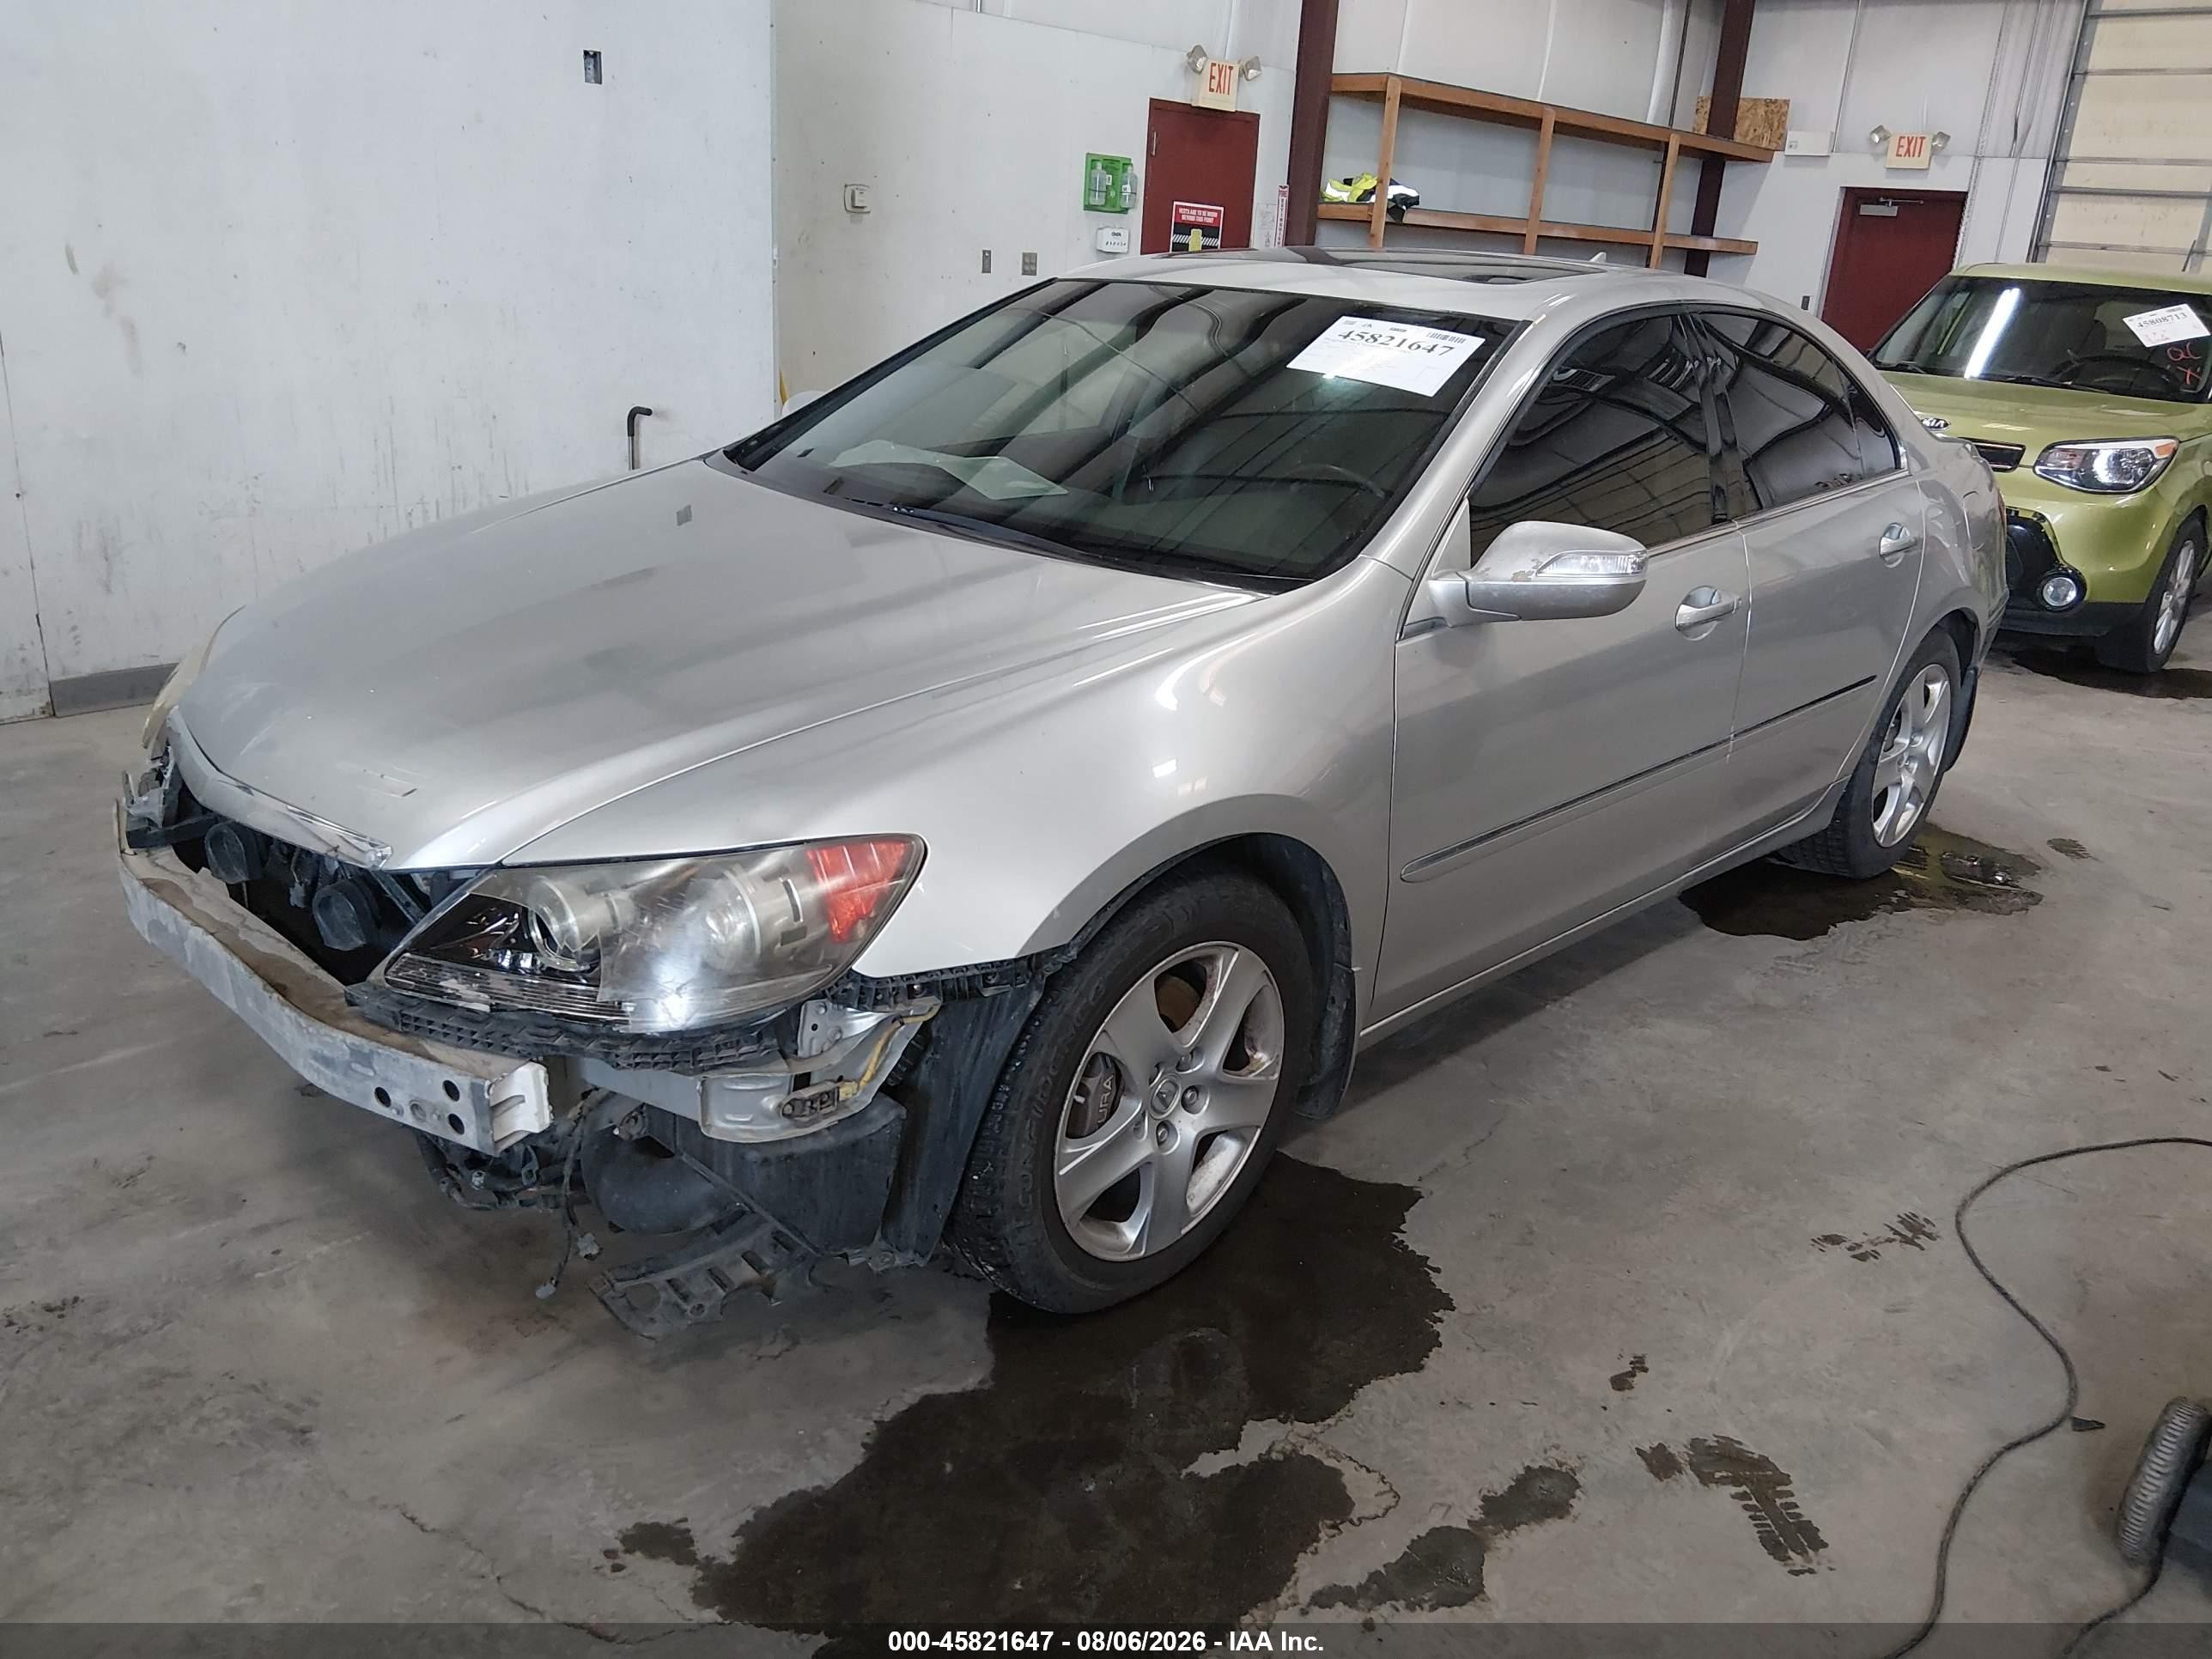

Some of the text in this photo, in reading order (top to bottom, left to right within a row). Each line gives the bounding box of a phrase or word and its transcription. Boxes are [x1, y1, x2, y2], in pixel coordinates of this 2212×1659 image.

[1209, 62, 1234, 95] EXIT
[1895, 136, 1926, 158] EXIT
[1338, 329, 1455, 356] 45821647
[1923, 418, 1945, 428] KIA
[1097, 1074, 1114, 1124] URA
